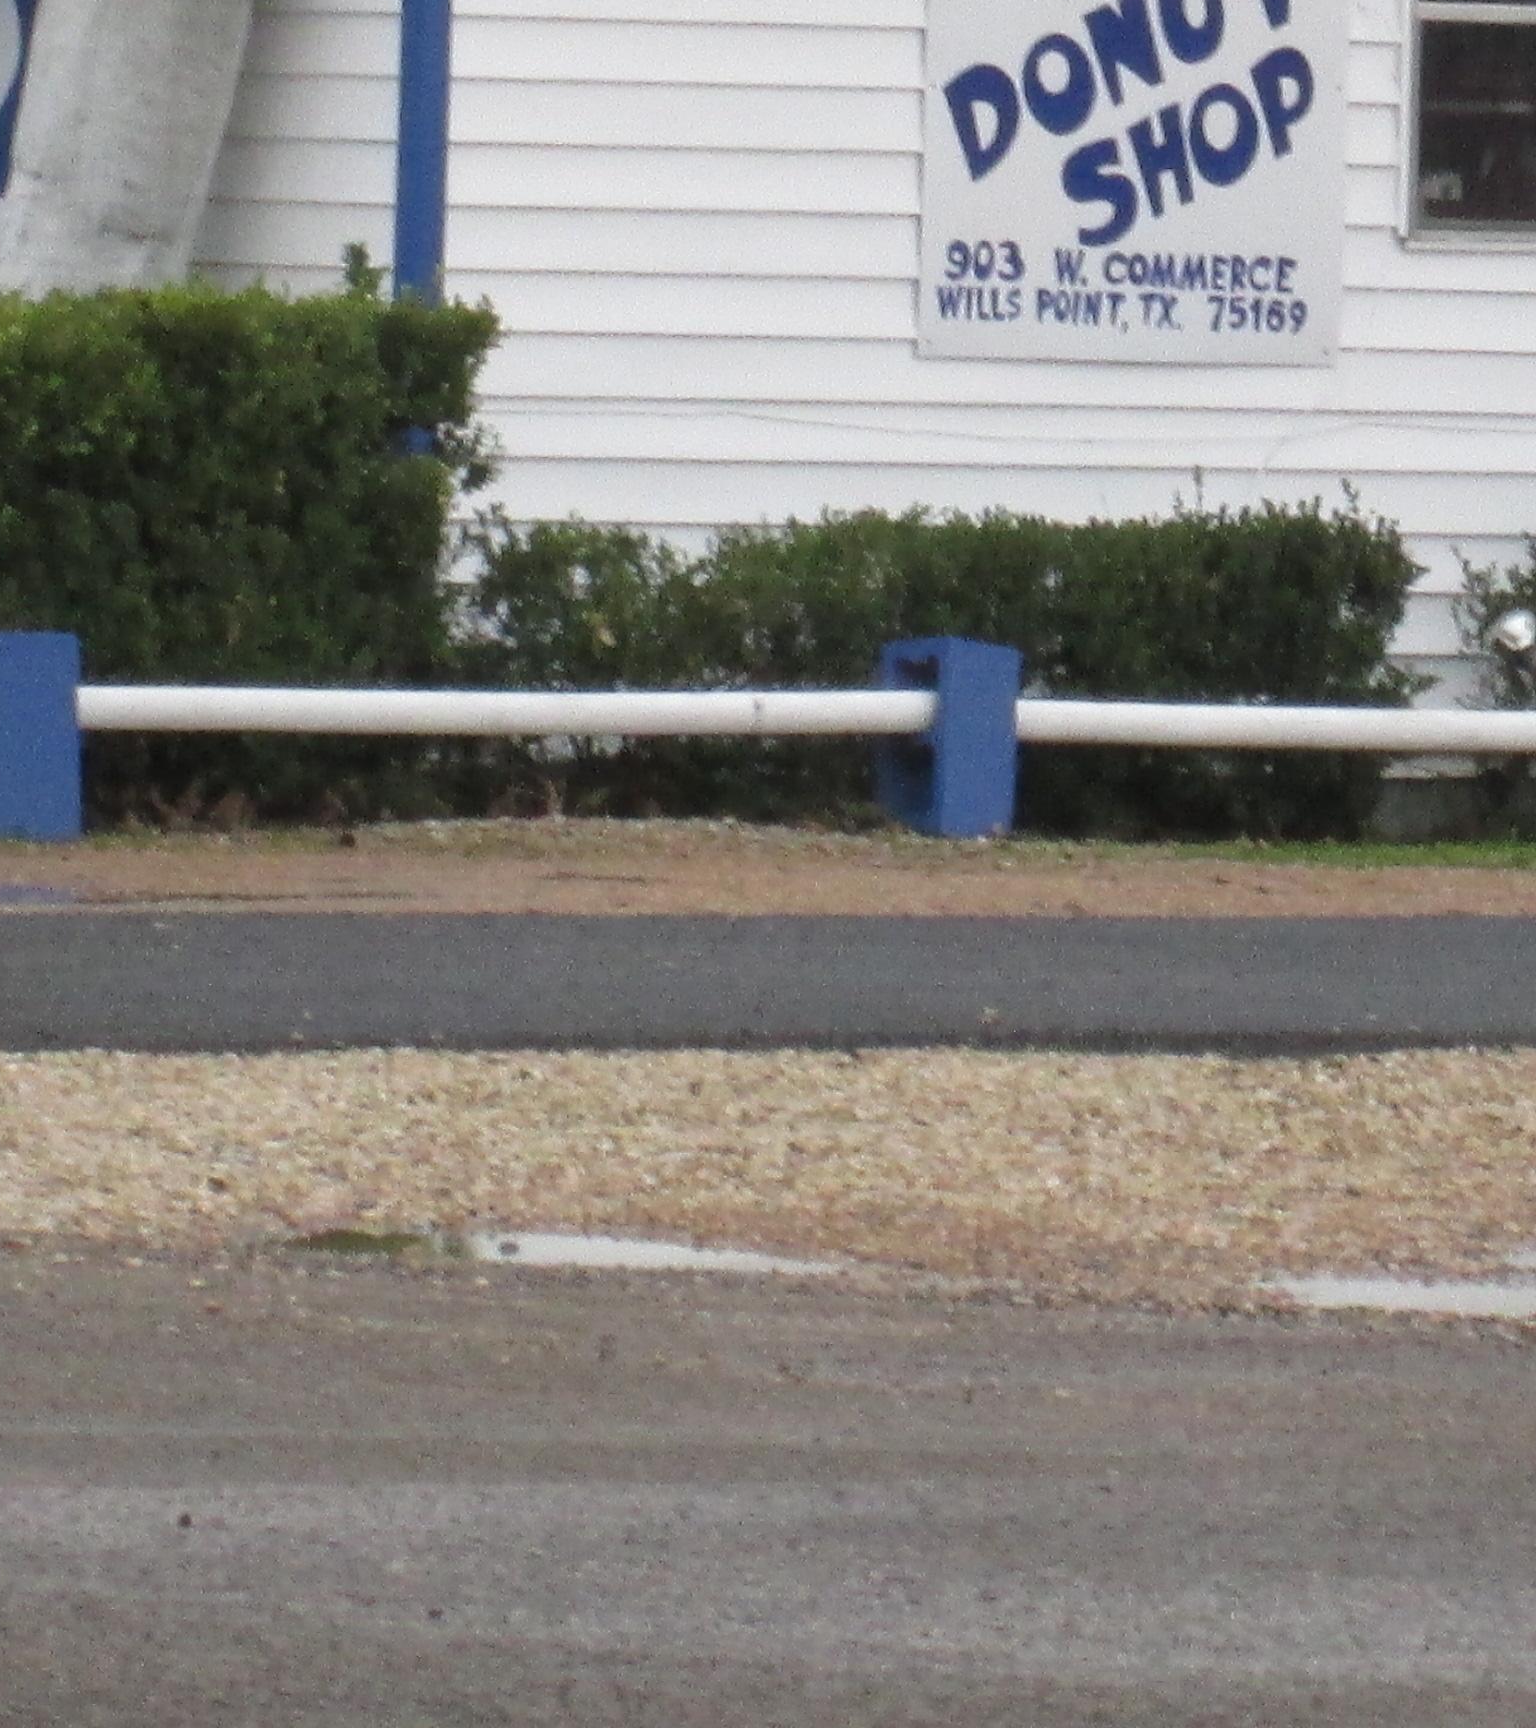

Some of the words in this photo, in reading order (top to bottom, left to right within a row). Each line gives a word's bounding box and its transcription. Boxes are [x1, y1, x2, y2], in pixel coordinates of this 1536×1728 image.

[1061, 46, 1314, 248] SHOP
[944, 239, 1026, 281] 903
[1054, 247, 1089, 286] W.
[1103, 251, 1297, 293] COMMERCE
[936, 285, 1021, 321] WILLS
[1036, 288, 1128, 332] POINT,
[1206, 295, 1308, 334] 75169
